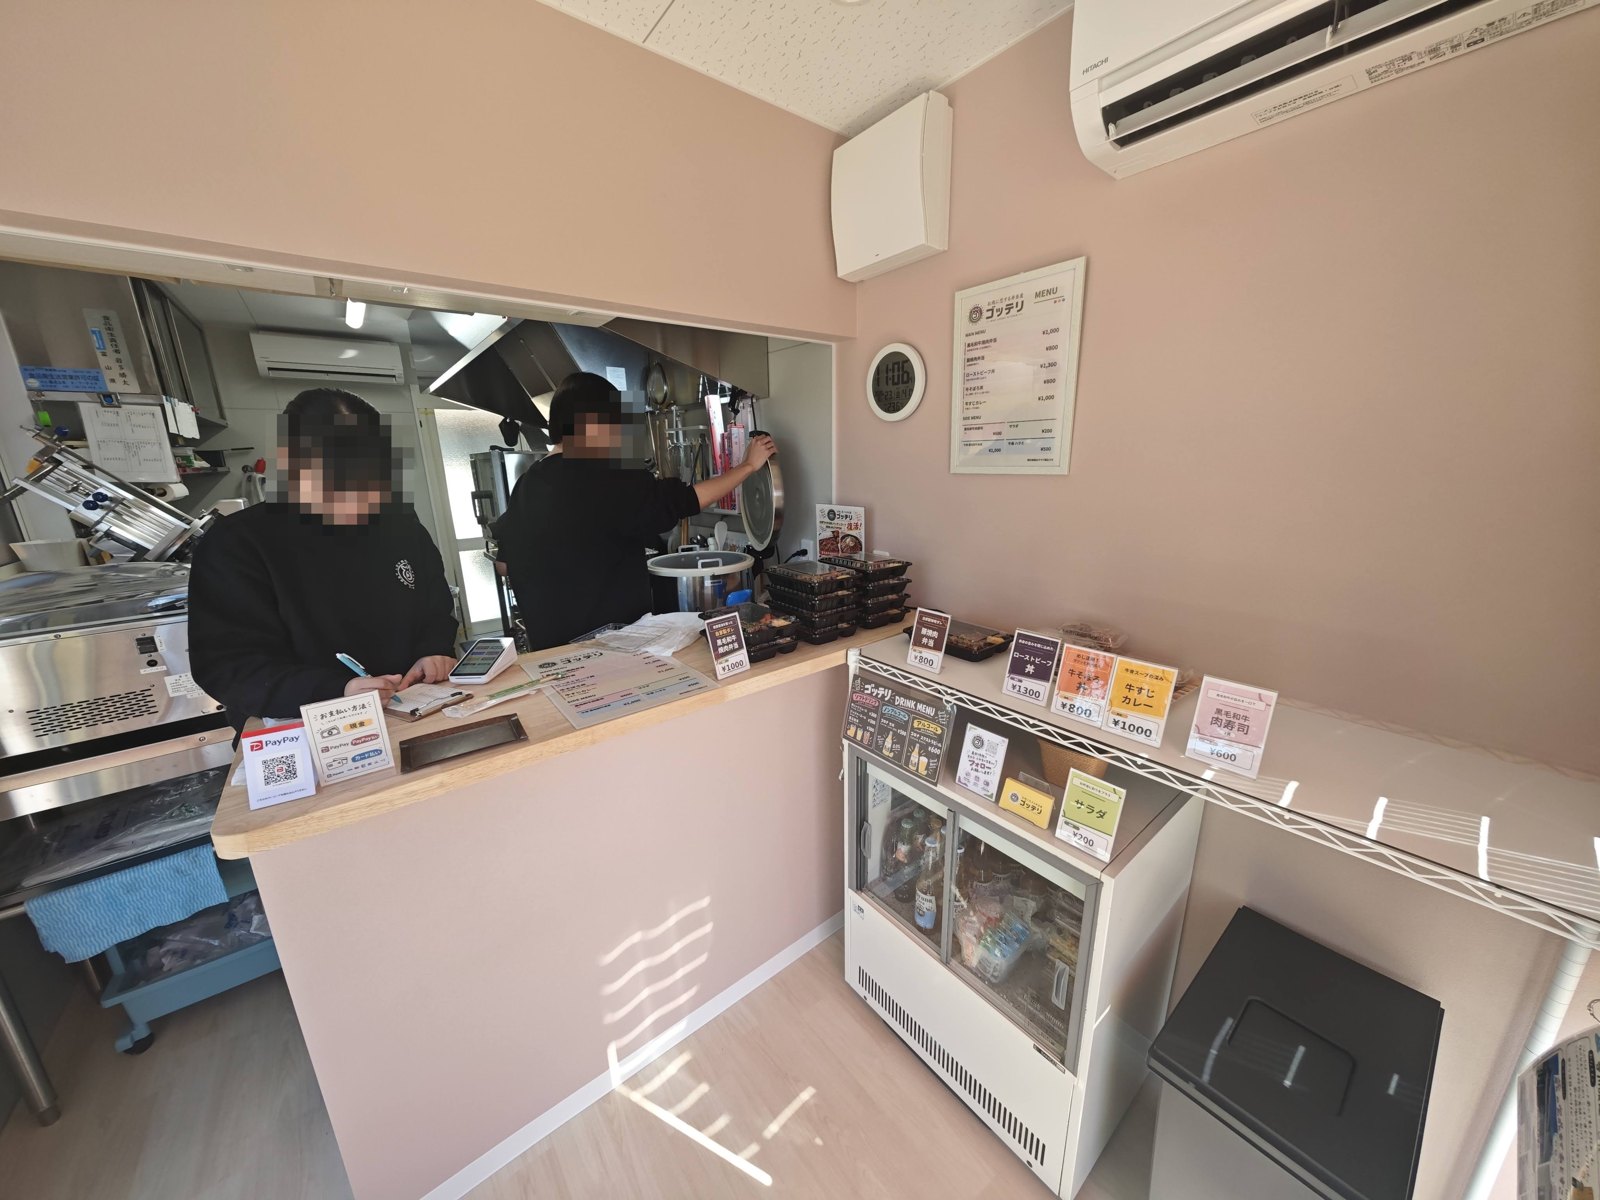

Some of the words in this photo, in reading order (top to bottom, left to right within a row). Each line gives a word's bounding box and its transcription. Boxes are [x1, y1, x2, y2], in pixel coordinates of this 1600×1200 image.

[1082, 57, 1109, 75] HITACHI
[1034, 287, 1058, 299] MENU
[985, 300, 1025, 320] ゴッテリ
[876, 360, 910, 387] 11:06
[716, 635, 737, 646] 黒毛和牛
[920, 627, 939, 639] 豚焼肉
[718, 642, 739, 654] 焼肉弁当
[921, 638, 935, 648] 弁当
[722, 660, 744, 672] ¥1000
[913, 653, 934, 667] ¥800
[1013, 651, 1053, 667] ローストビーフ
[1025, 664, 1036, 675] 丼
[864, 684, 892, 701] ゴッテリ
[1011, 682, 1041, 699] ¥1300
[1125, 683, 1155, 699] 牛すじ
[894, 696, 916, 710] DRINK
[916, 702, 936, 716] MENU
[1060, 701, 1092, 718] ¥800
[1122, 695, 1154, 710] カレー
[319, 703, 367, 720] お支払い方法
[1214, 707, 1251, 723] 黒毛和牛
[349, 721, 366, 730] 現金
[916, 720, 939, 732] アルコール
[1112, 718, 1153, 738] ¥1000
[1210, 716, 1251, 736] 肉寿司
[264, 734, 300, 748] PayPay
[329, 741, 350, 751] PayPay
[354, 750, 382, 762] カード払い
[1209, 747, 1237, 762] ¥600
[968, 759, 992, 771] フォロー
[1019, 799, 1043, 815] ゴッテリ
[1074, 799, 1107, 820] サラダ
[1072, 830, 1095, 847] ¥200
